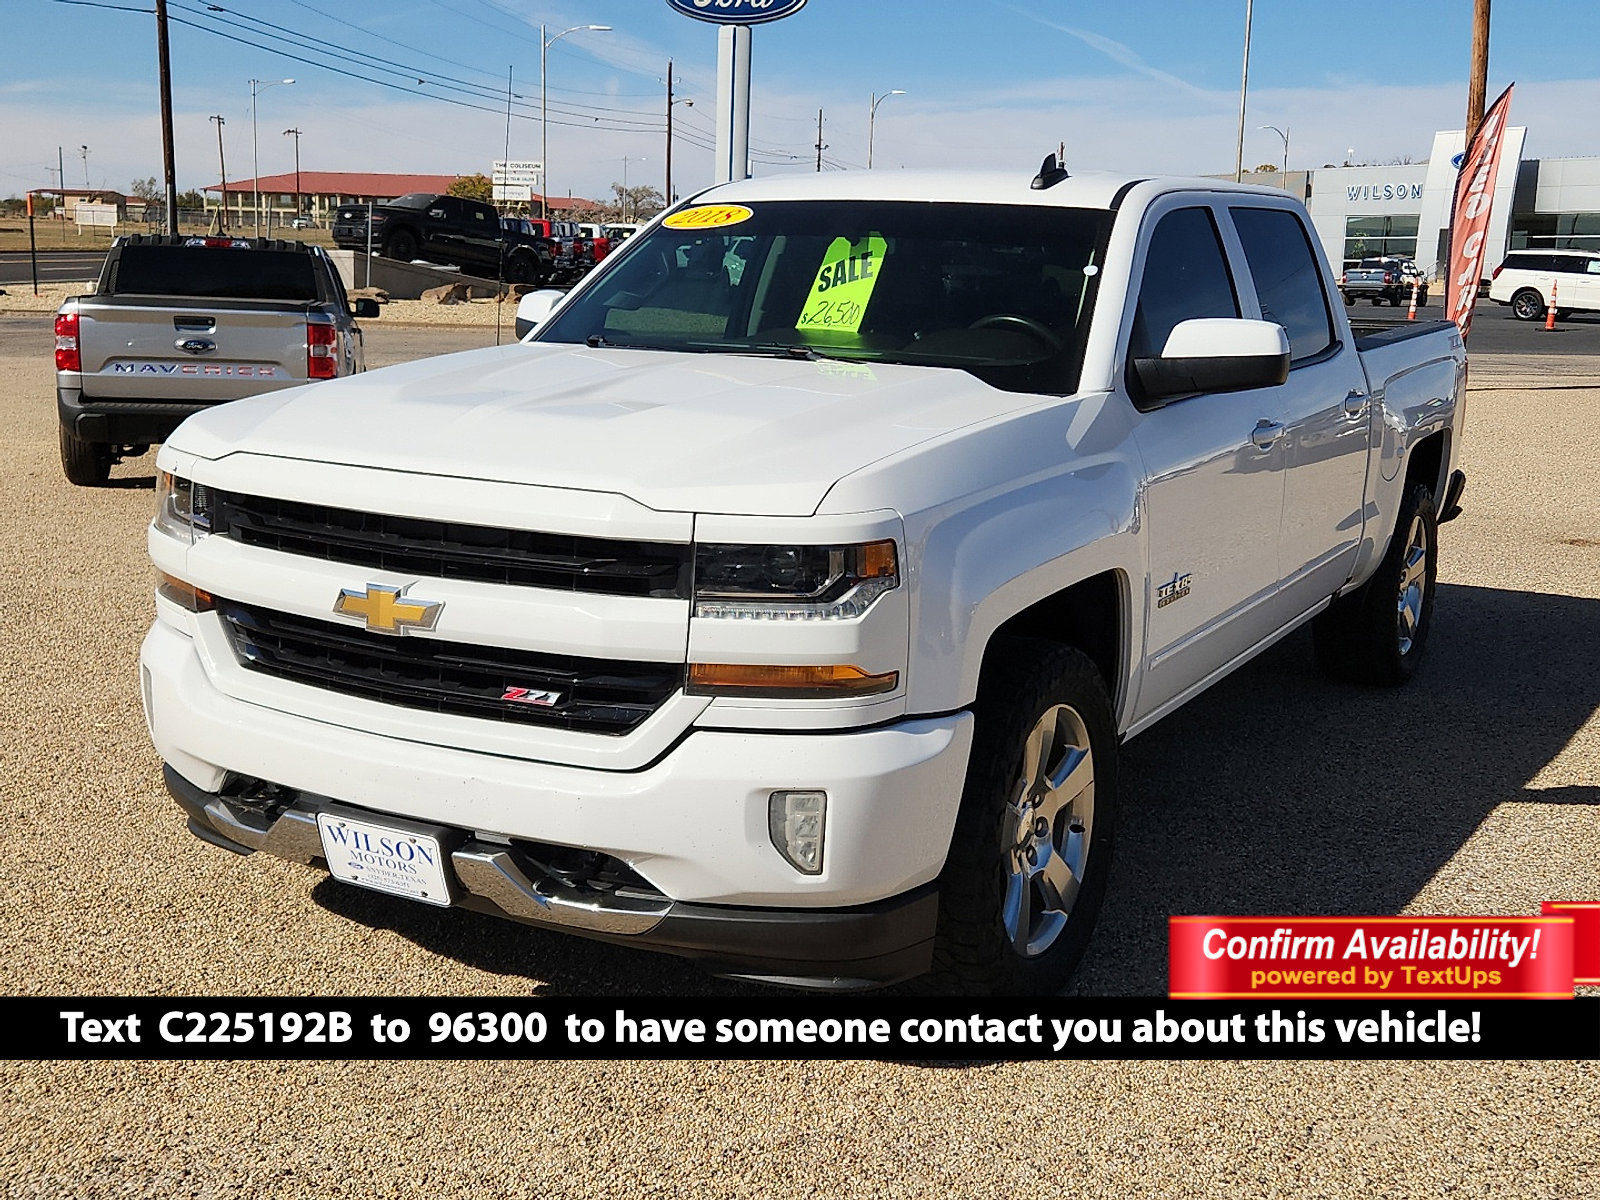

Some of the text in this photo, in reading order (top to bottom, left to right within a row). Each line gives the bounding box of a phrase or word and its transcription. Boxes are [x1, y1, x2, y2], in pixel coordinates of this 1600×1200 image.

[1347, 184, 1423, 201] WILSON
[670, 209, 743, 225] 2018
[818, 251, 874, 293] SALE
[115, 363, 275, 377] MAVERICK
[501, 686, 562, 707] Z71
[326, 824, 435, 867] WILSON
[350, 850, 417, 875] MOTORS
